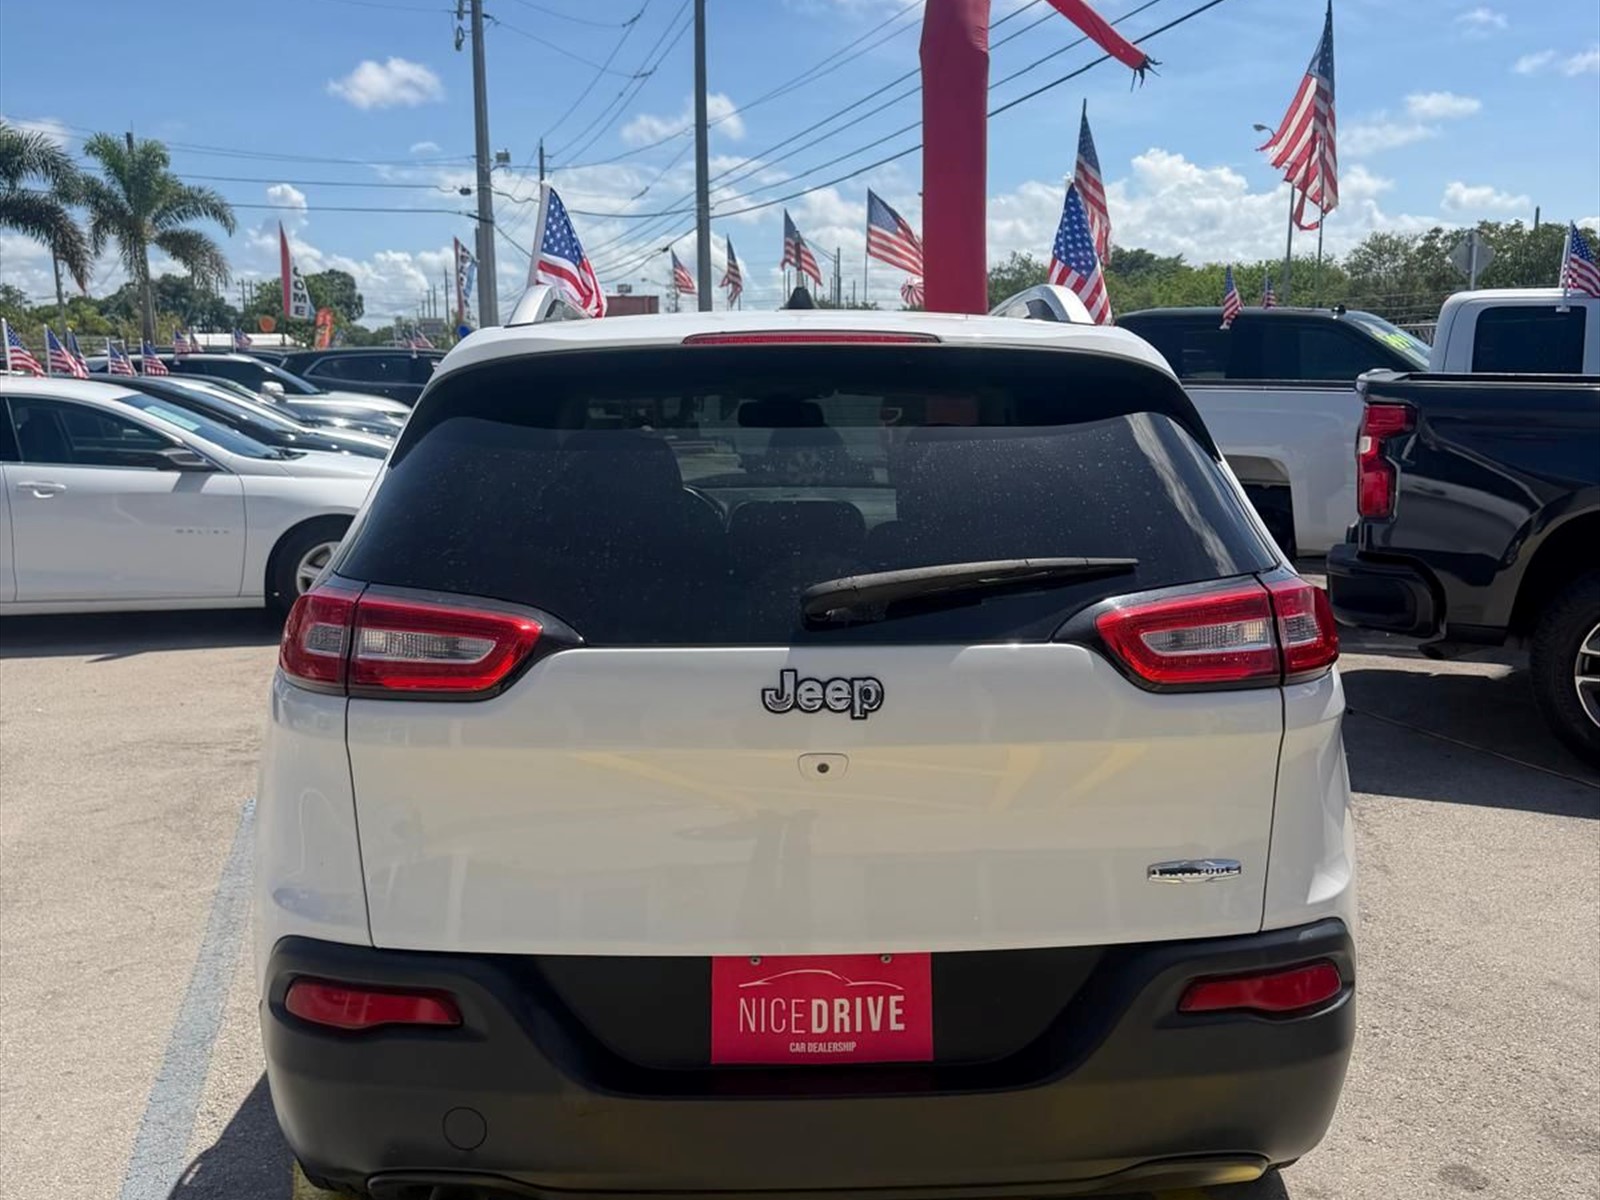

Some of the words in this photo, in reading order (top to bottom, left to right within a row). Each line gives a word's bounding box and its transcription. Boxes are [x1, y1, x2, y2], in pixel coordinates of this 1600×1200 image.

[761, 669, 884, 720] Jeep
[789, 1042, 806, 1053] CAR
[807, 1041, 857, 1053] DEALERSHIP
